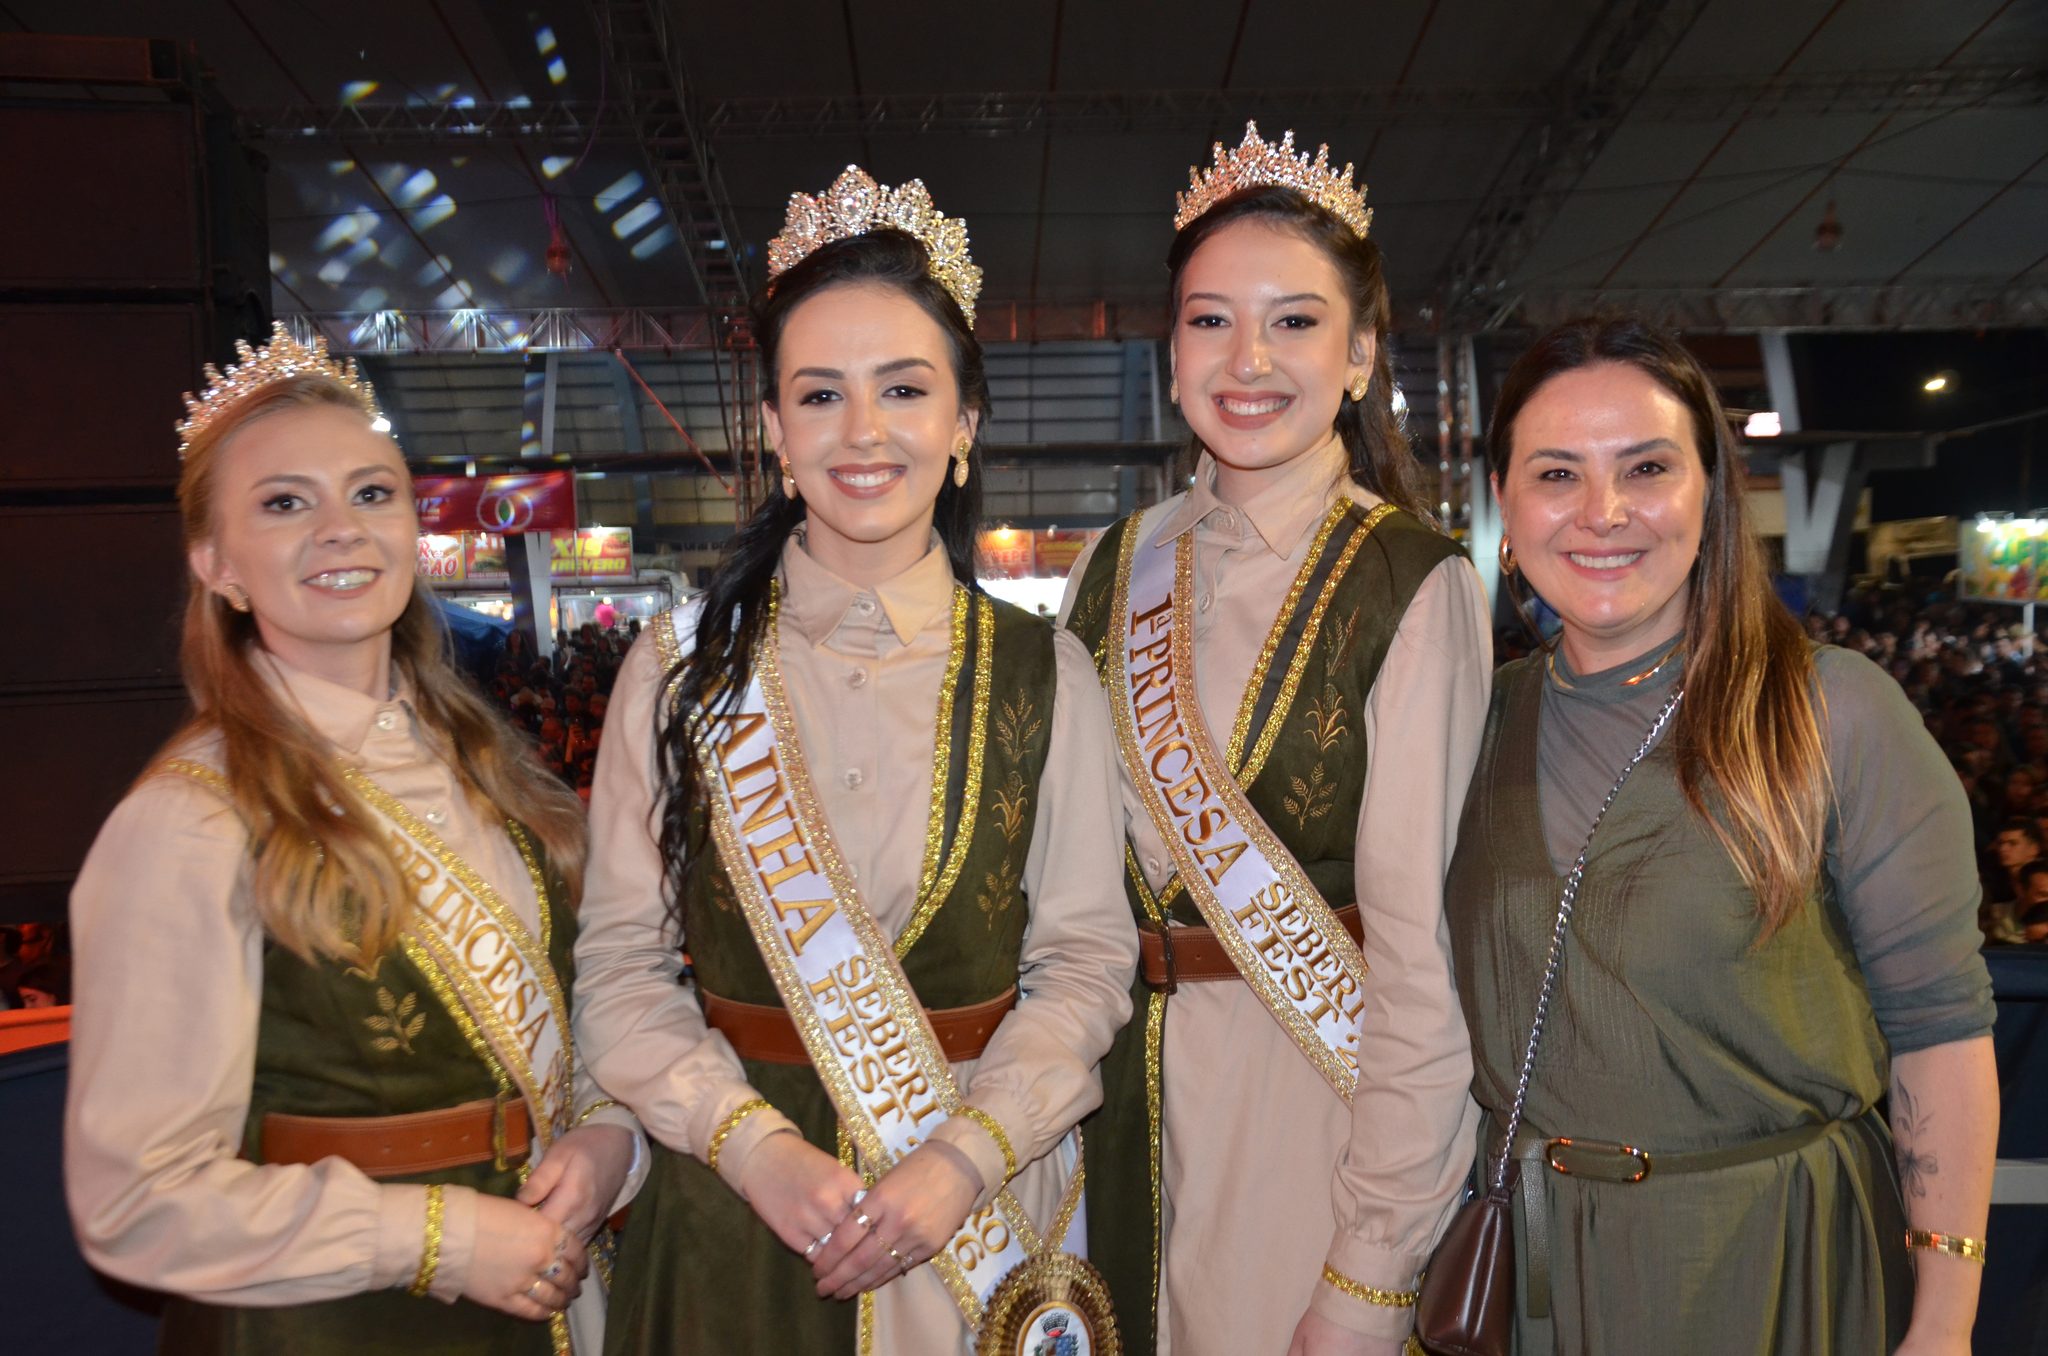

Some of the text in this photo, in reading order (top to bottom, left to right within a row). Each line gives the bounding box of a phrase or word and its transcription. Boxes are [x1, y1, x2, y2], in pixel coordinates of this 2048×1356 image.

[552, 537, 602, 558] XIS
[699, 672, 839, 957] AINHA
[1129, 635, 1249, 888] PRINCESA
[1230, 896, 1340, 1028] FEST
[1255, 880, 1366, 1025] SEBERI
[807, 968, 904, 1126] FEST
[834, 954, 940, 1128] SEBERI
